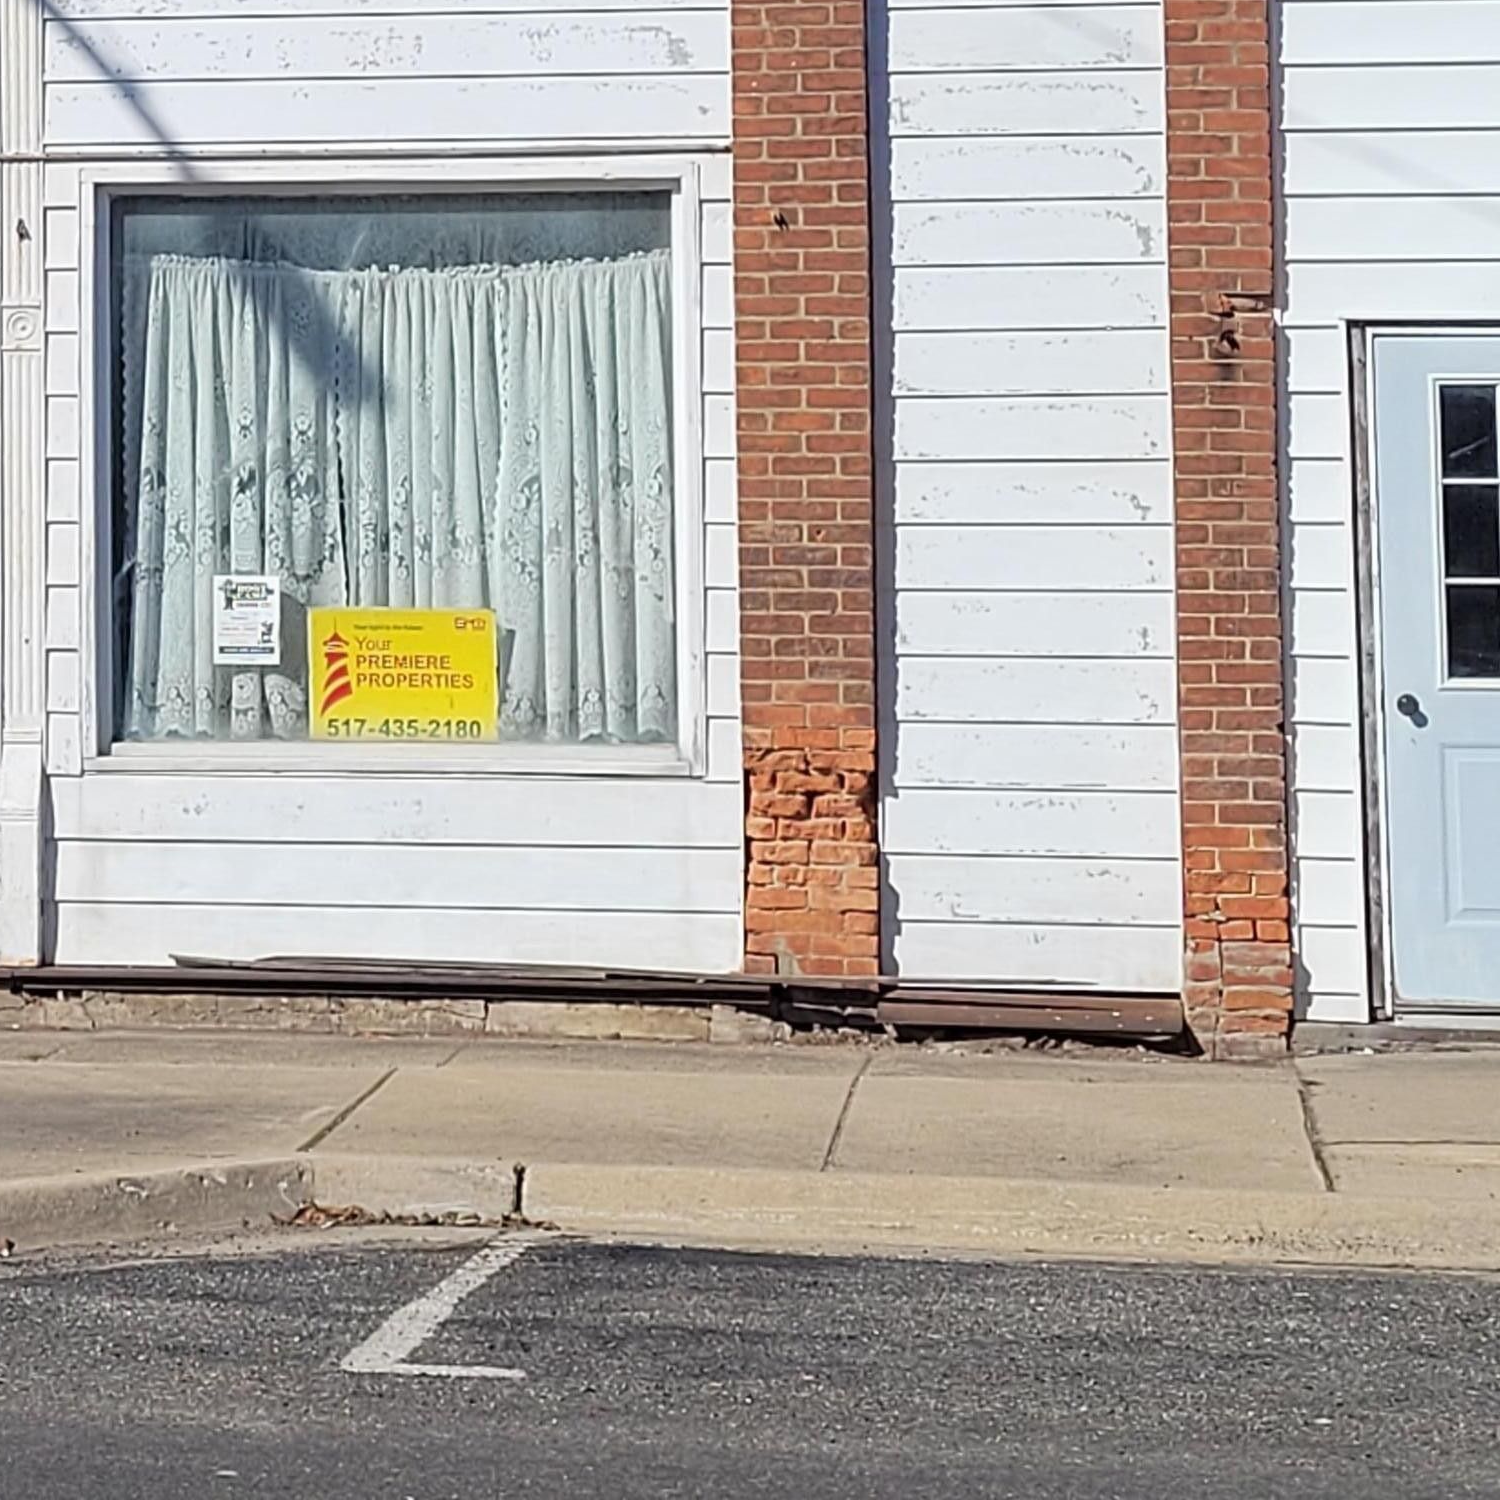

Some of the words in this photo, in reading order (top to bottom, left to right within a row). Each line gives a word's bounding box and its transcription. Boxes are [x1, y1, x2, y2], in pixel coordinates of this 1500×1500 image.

[355, 637, 392, 651] Your
[356, 654, 451, 670] PREMIERE
[356, 673, 474, 689] PROPERTIES
[327, 718, 481, 738] 517-435-2180
